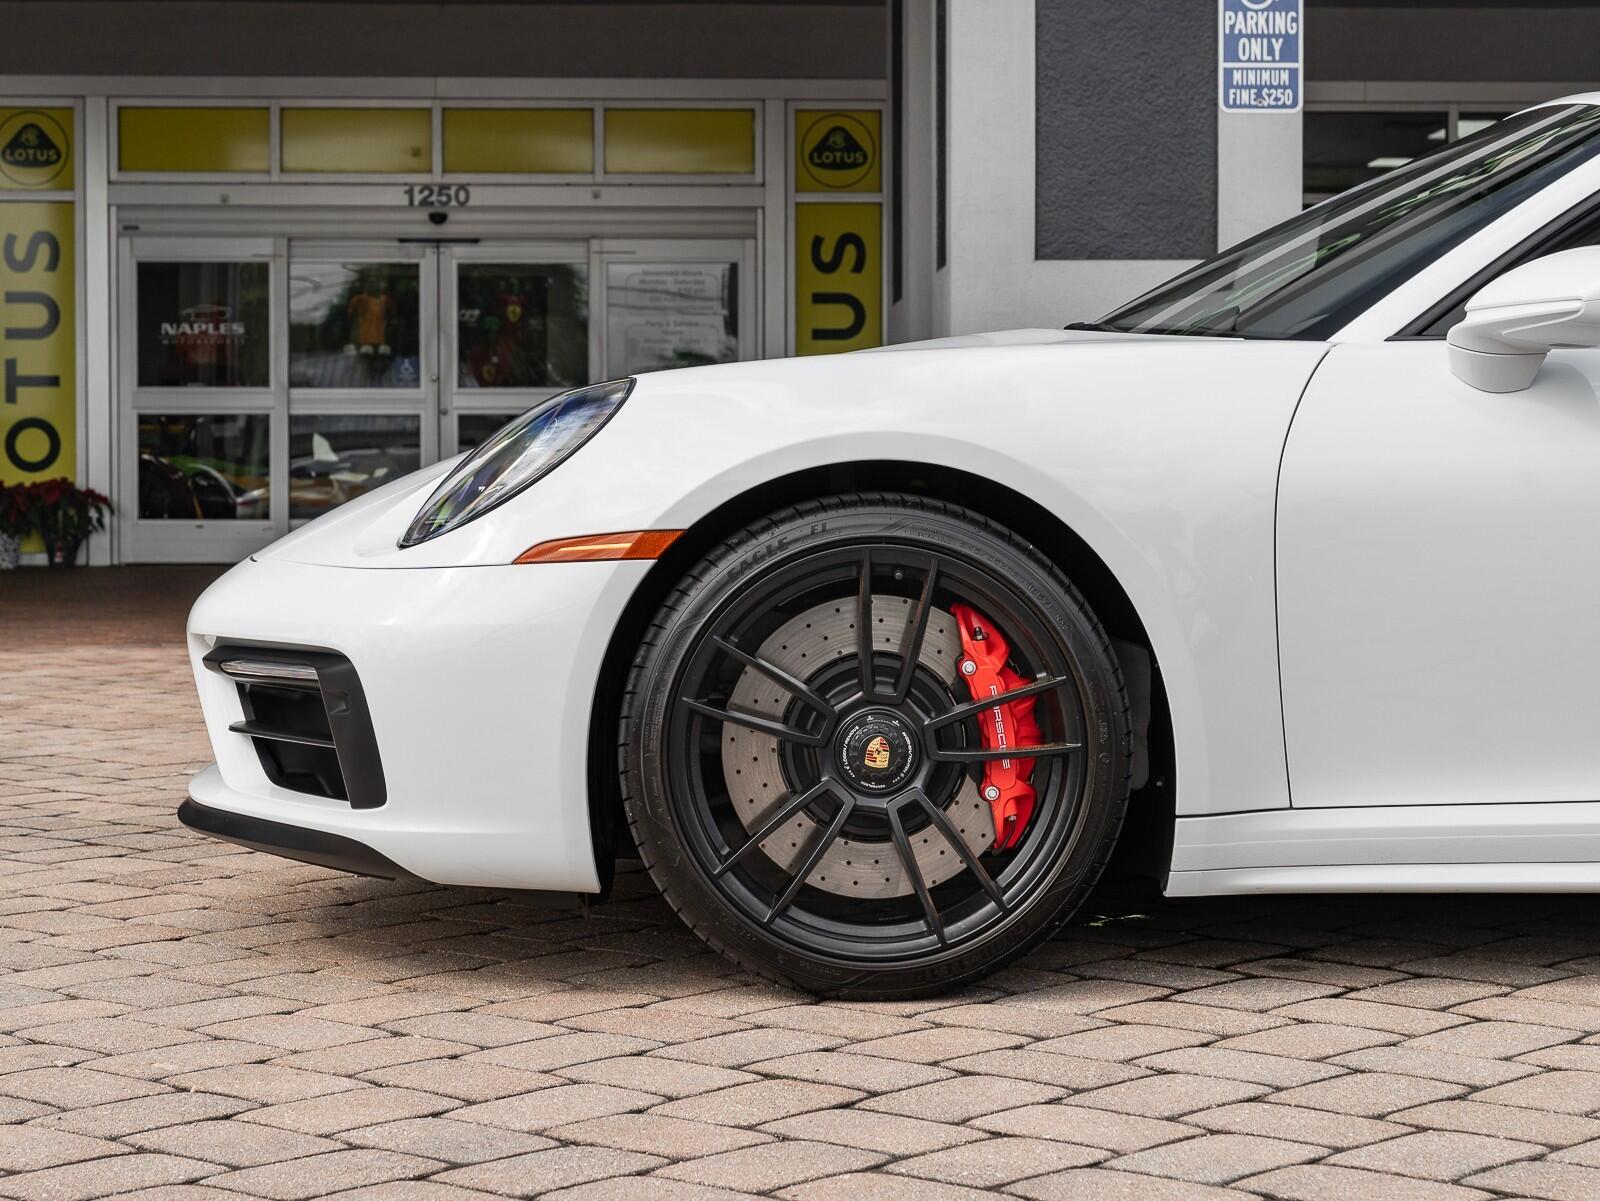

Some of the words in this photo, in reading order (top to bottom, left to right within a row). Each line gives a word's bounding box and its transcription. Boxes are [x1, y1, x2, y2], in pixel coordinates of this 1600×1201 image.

[1224, 10, 1298, 35] PARKING
[1238, 37, 1284, 61] ONLY
[1232, 69, 1289, 86] MINIMUM
[1228, 88, 1257, 106] FINE
[1261, 87, 1293, 107] $250
[5, 149, 58, 161] LOTUS
[813, 151, 865, 164] LOTUS
[403, 185, 471, 207] 1250
[160, 322, 245, 336] NAPLES
[3, 229, 62, 474] OTUS
[989, 684, 1011, 770] PRSCE
